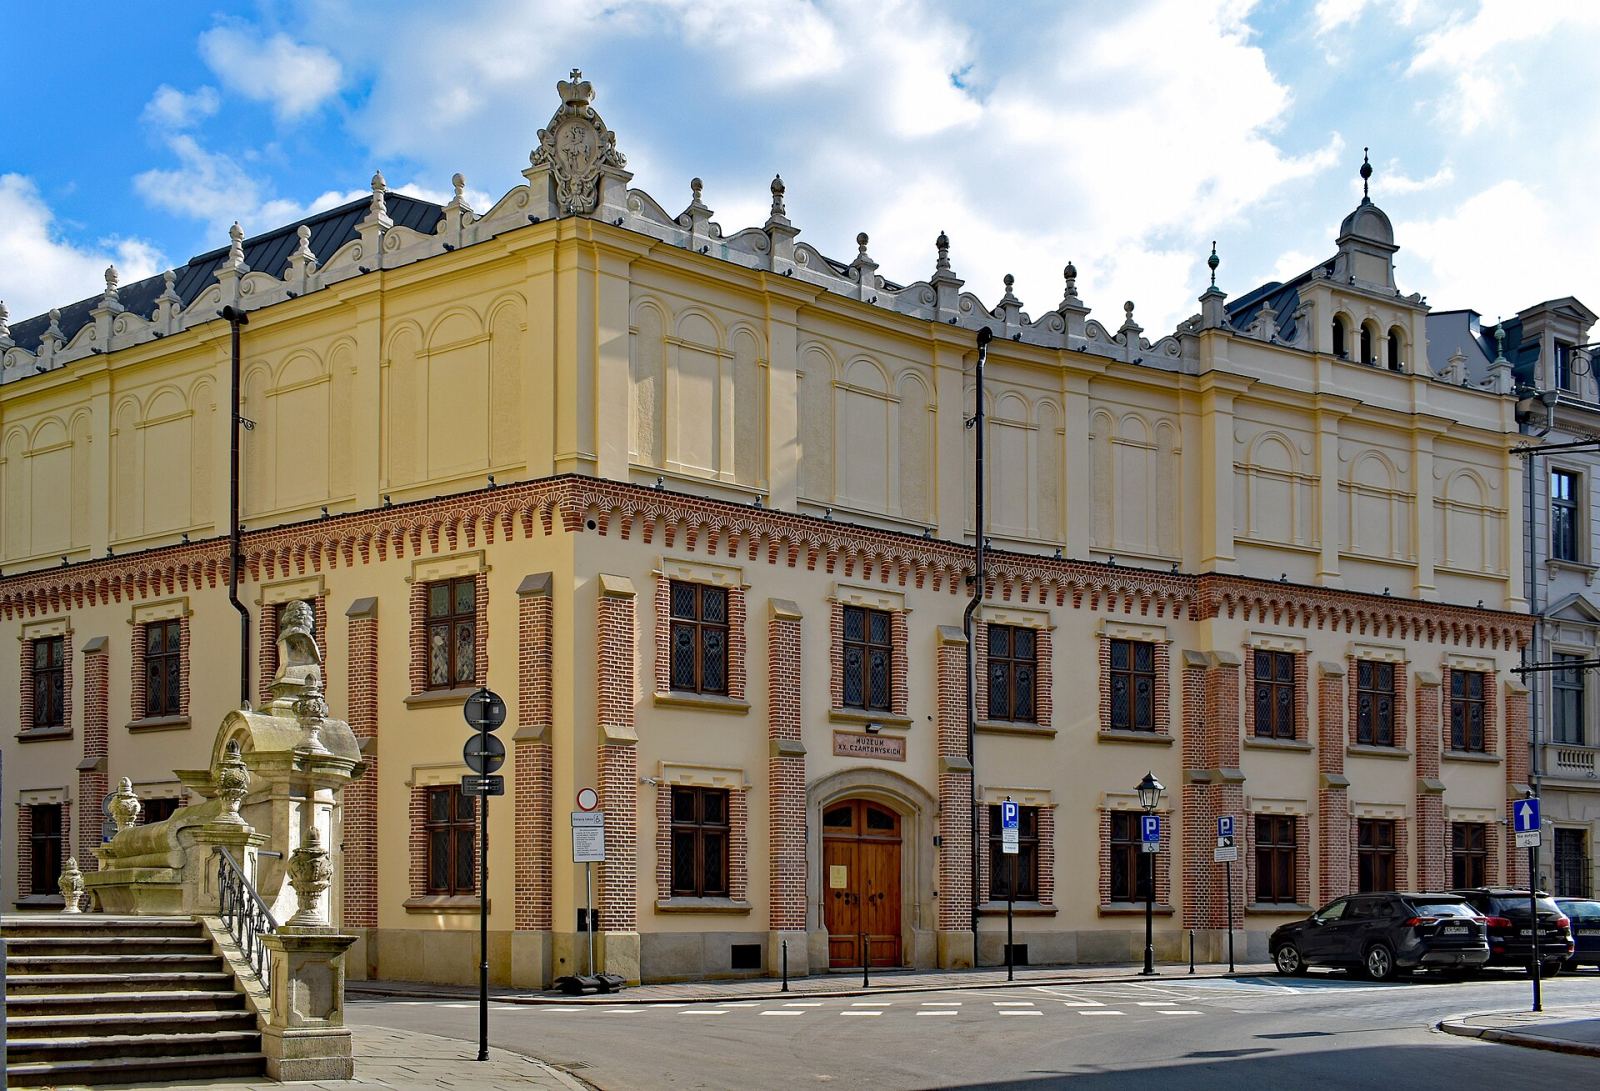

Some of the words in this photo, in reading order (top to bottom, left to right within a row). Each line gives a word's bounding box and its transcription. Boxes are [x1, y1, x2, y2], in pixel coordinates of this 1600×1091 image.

[856, 737, 884, 746] MUZEUM
[850, 744, 901, 756] CZARTORYSKICH
[1006, 804, 1015, 821] P
[1146, 818, 1156, 835] P
[1220, 818, 1230, 834] P
